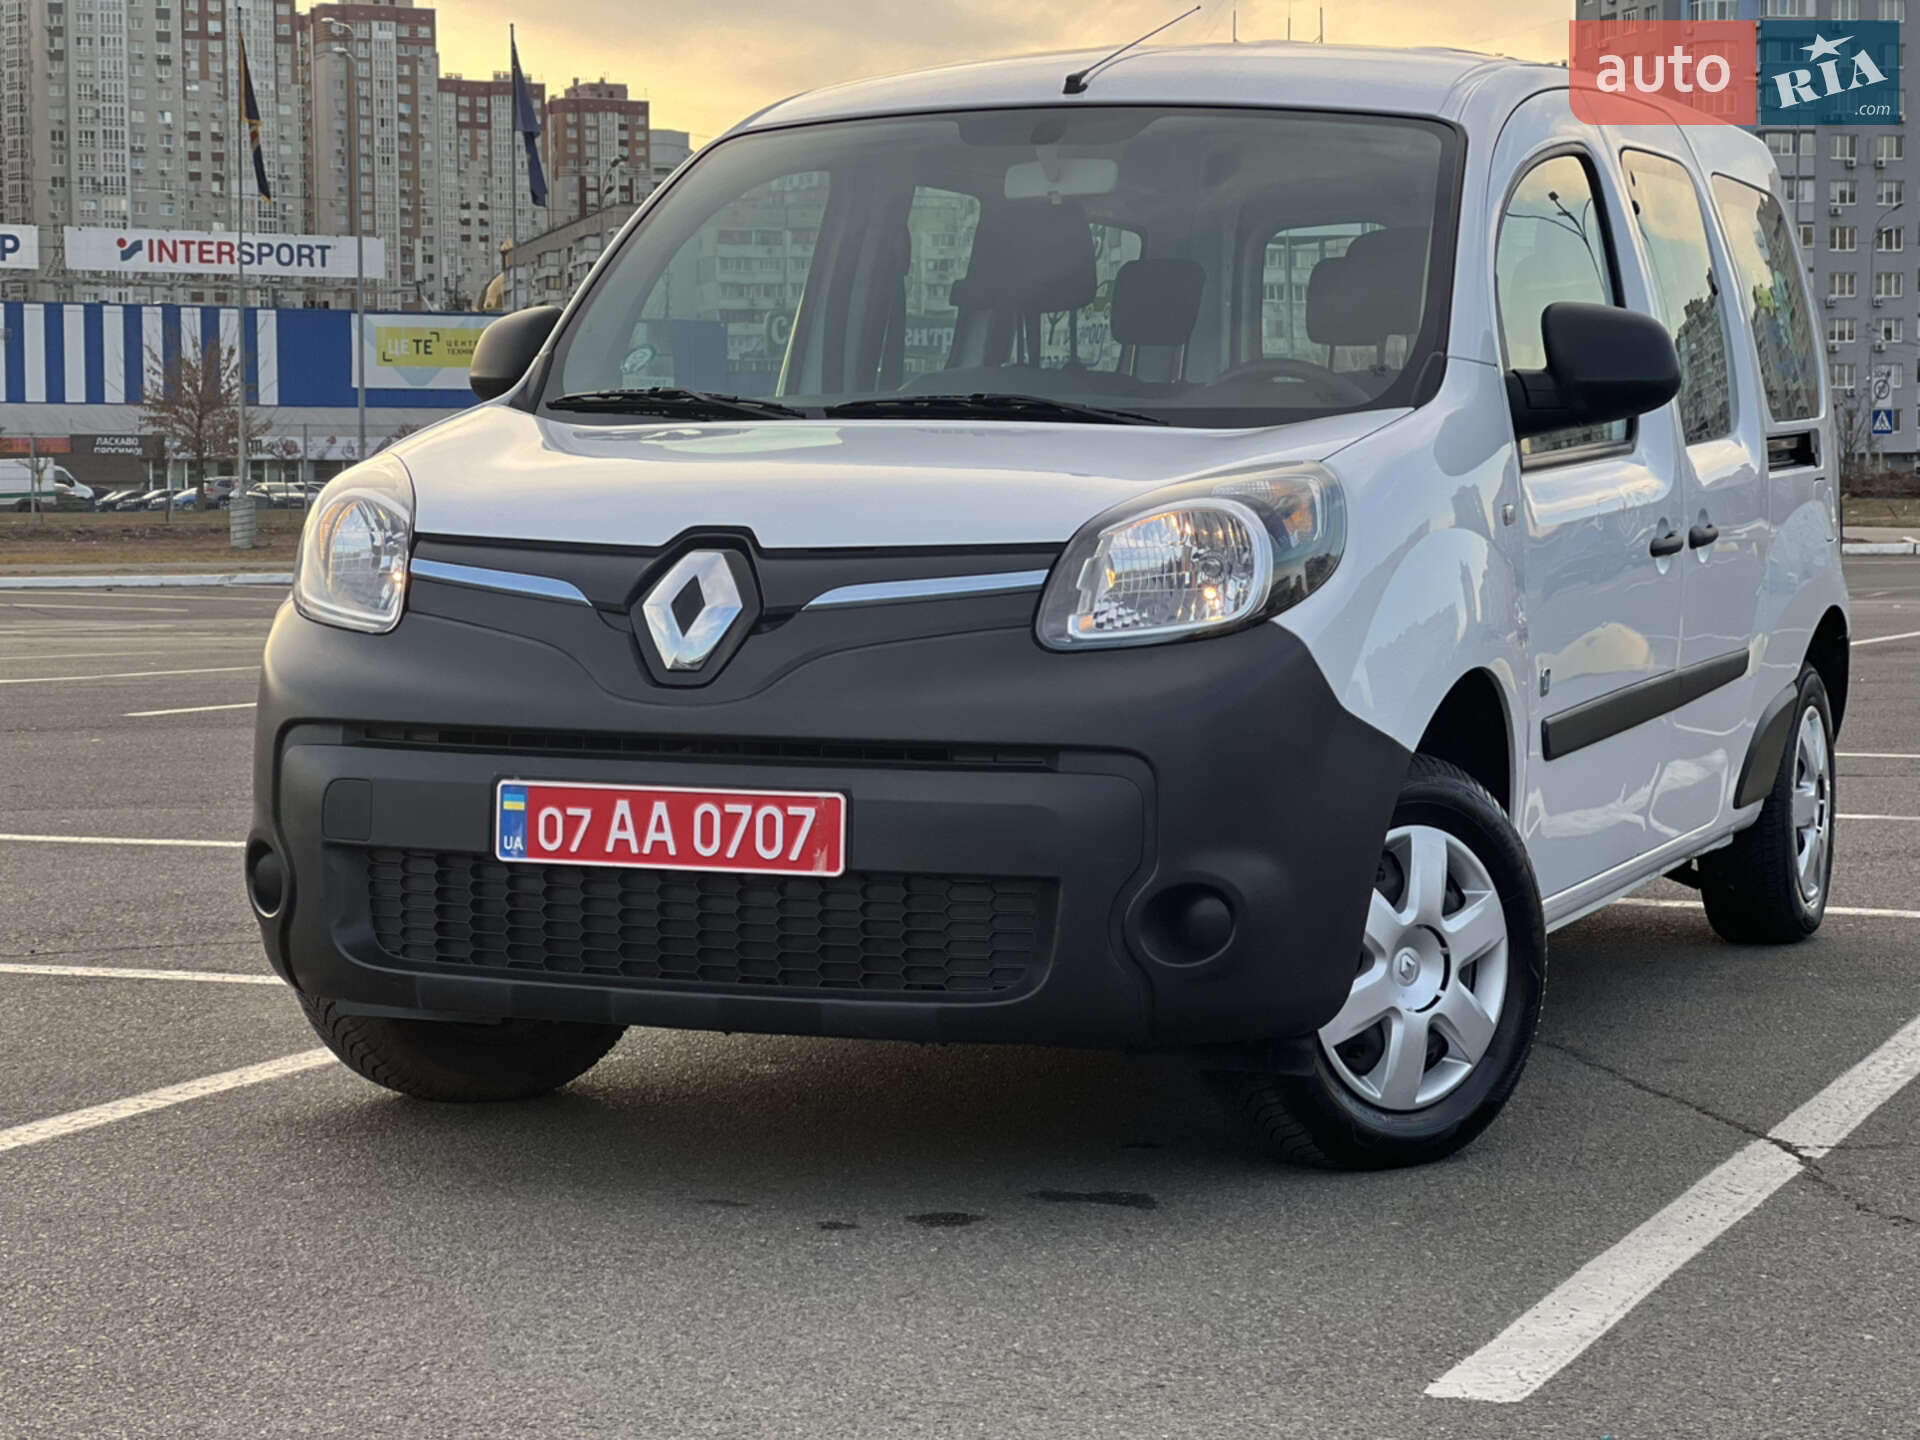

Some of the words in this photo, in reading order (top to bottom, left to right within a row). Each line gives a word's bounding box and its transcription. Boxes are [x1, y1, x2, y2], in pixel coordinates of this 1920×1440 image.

[148, 239, 331, 268] INTERSPORT
[96, 436, 139, 446] ЛАСКАВО
[538, 806, 592, 853] 07
[605, 799, 677, 856] AA
[693, 803, 816, 861] 0707
[503, 836, 524, 851] UA
